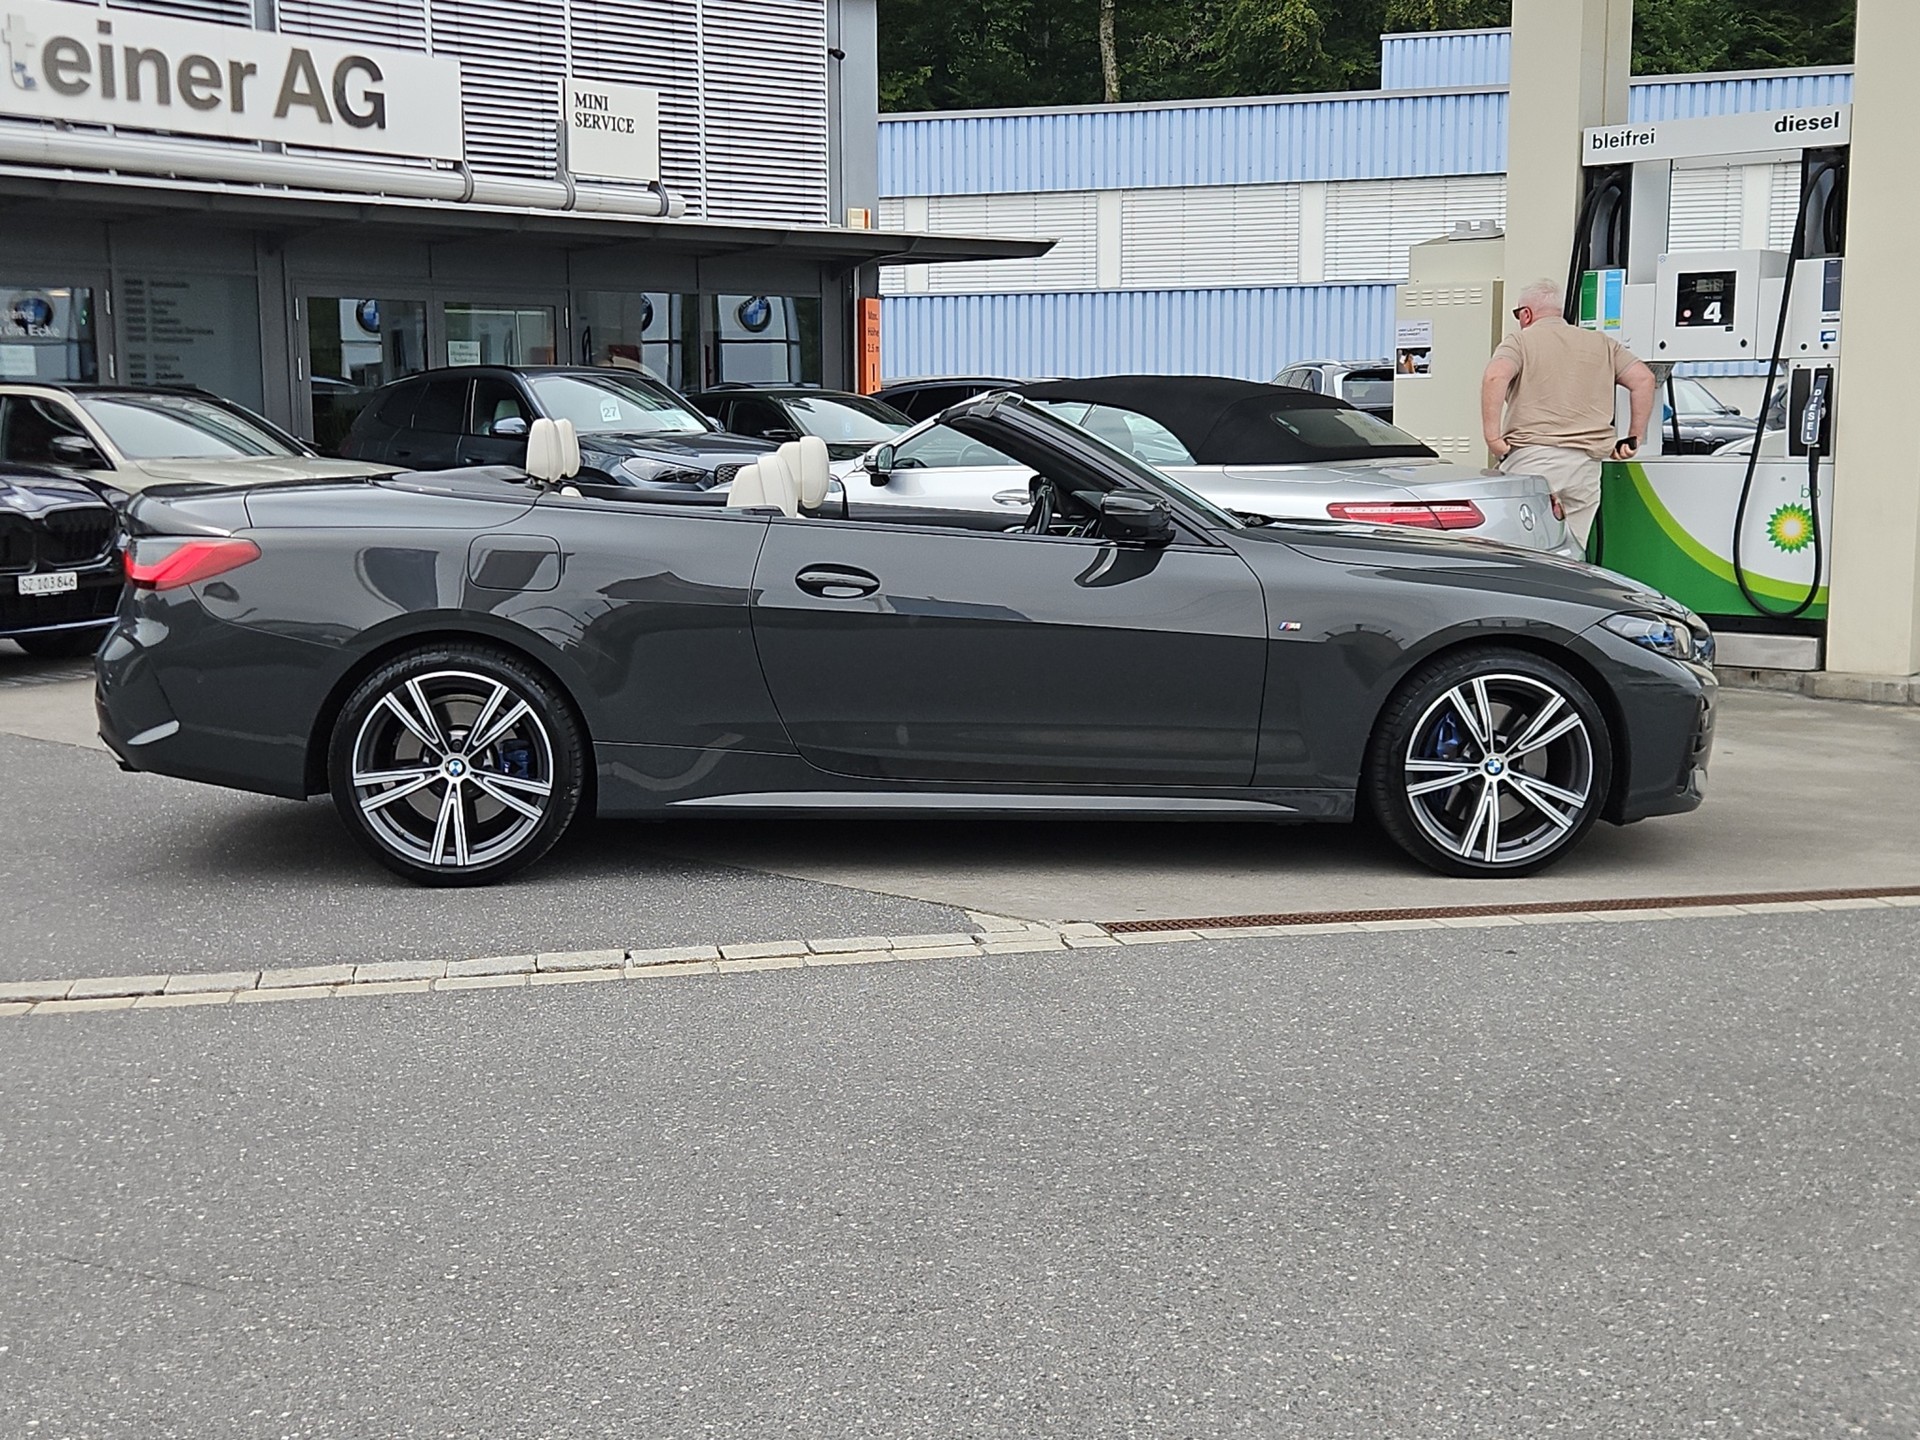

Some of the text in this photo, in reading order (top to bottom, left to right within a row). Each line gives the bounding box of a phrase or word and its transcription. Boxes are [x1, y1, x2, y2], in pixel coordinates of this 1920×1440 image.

[274, 47, 386, 129] AG
[574, 92, 608, 111] MINI
[575, 112, 634, 133] SERVICE
[1592, 111, 1840, 149] bleifrei diesel
[1703, 302, 1721, 322] 4
[603, 406, 617, 418] 27
[1806, 389, 1822, 440] DIESEL
